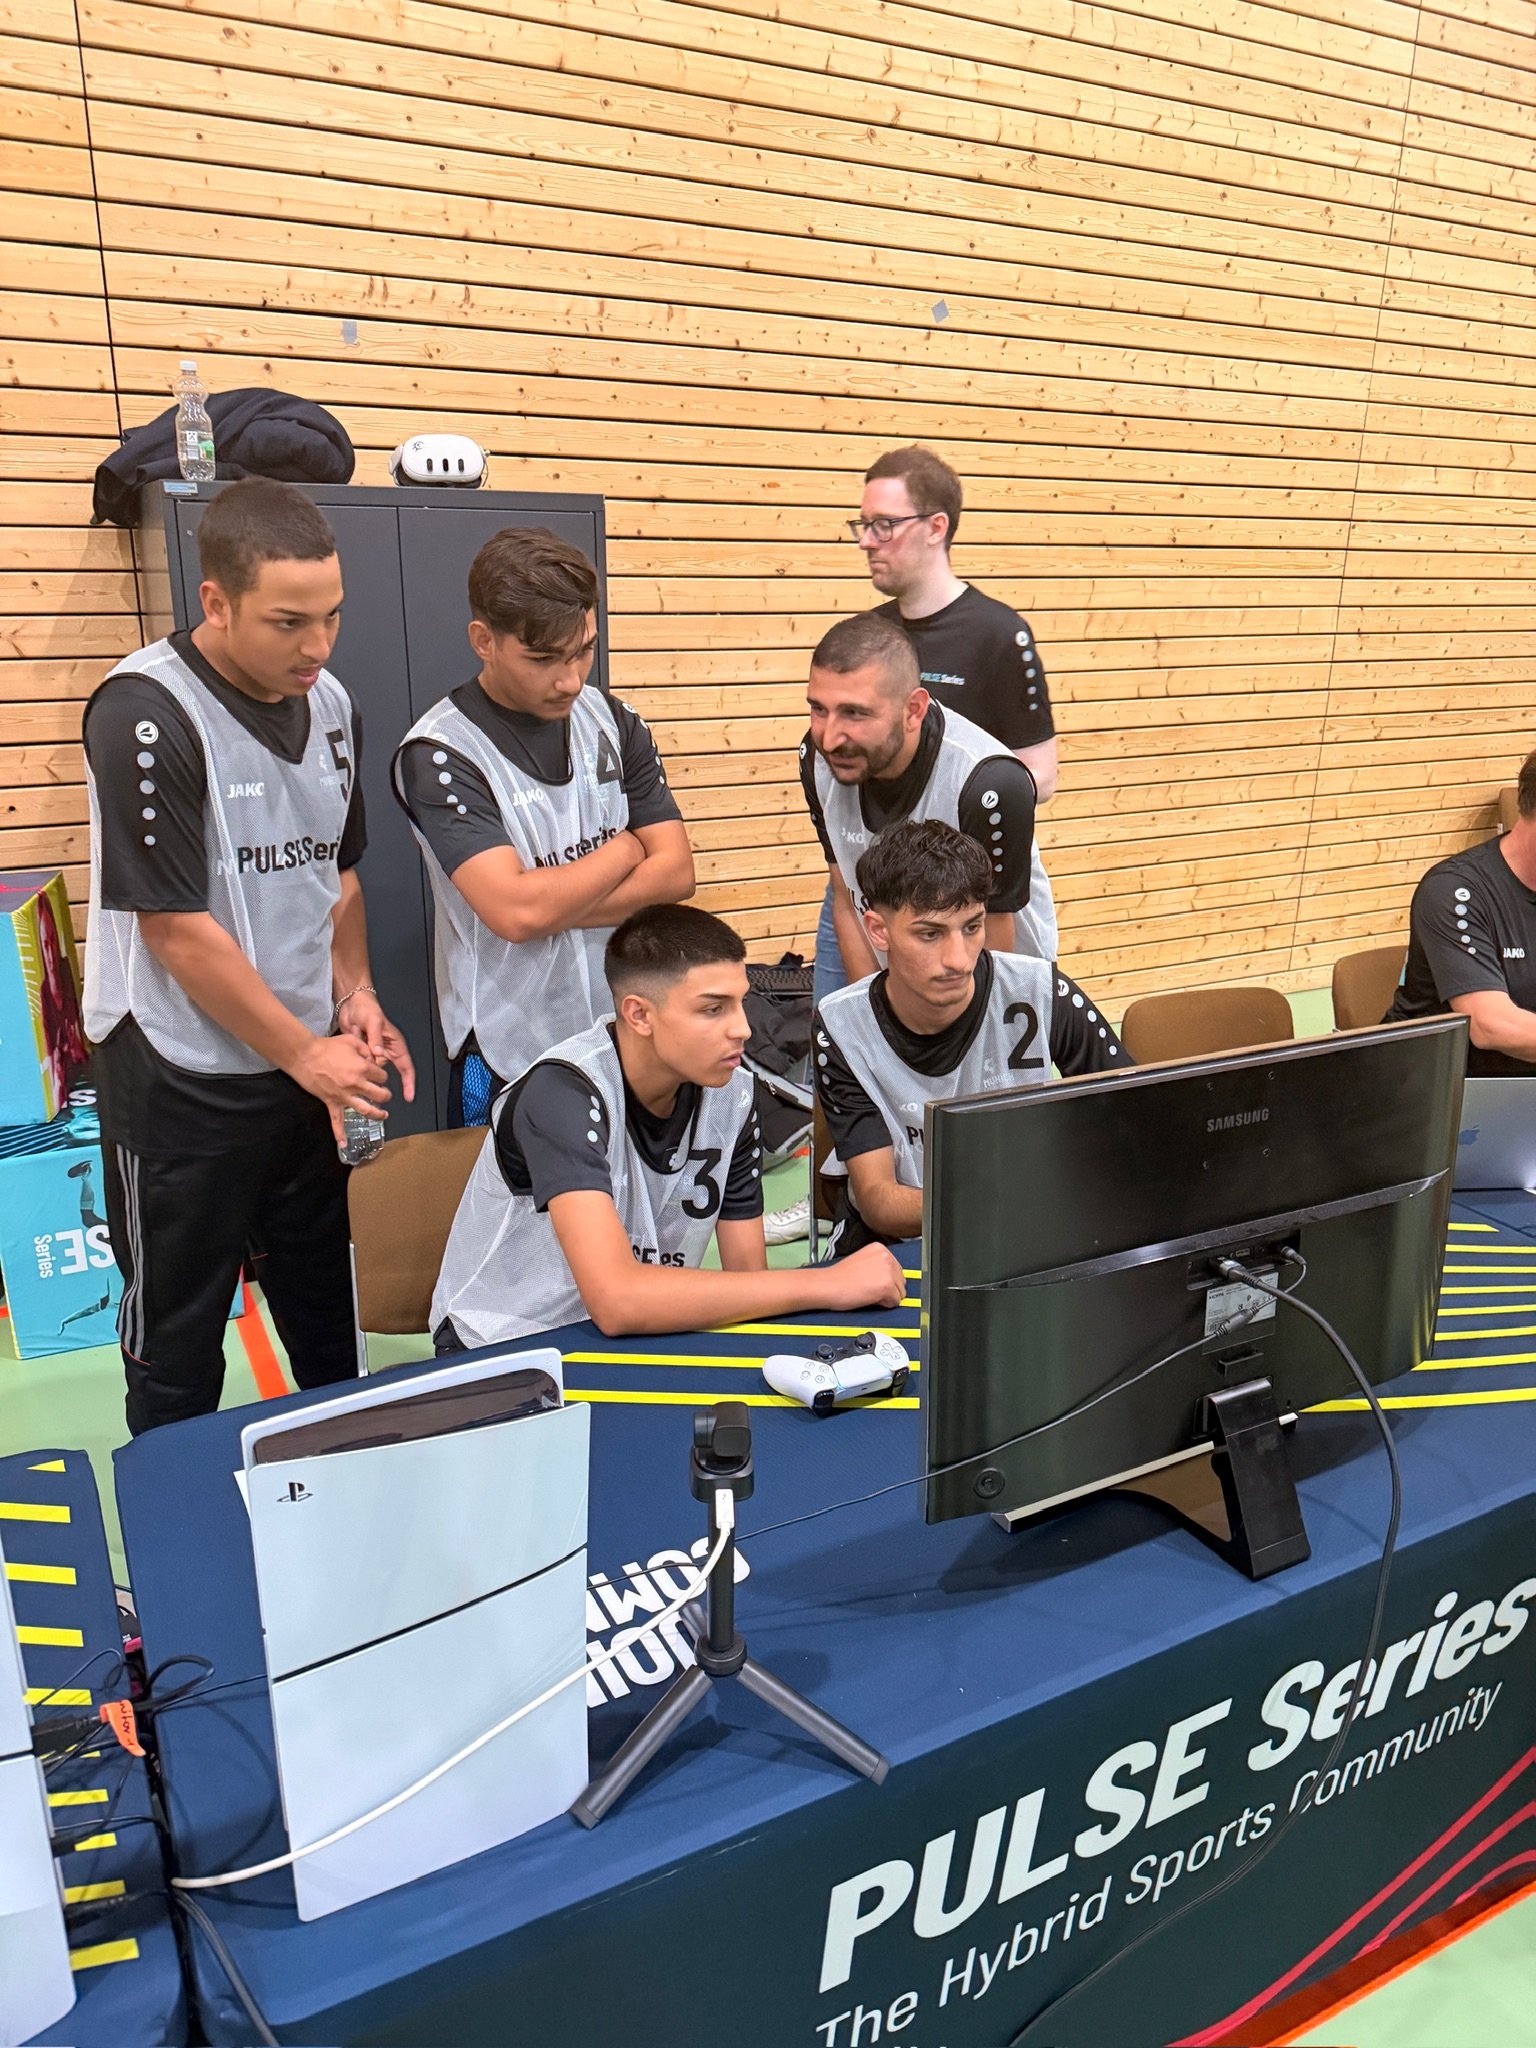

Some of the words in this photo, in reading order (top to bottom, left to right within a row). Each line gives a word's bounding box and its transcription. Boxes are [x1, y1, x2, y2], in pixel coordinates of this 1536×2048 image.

[596, 730, 627, 795] 4
[841, 827, 864, 843] JKO
[1503, 947, 1525, 959] JAKO
[1003, 1001, 1044, 1070] 2
[1207, 1107, 1269, 1133] SAMSUNG
[681, 1148, 722, 1220] 3
[33, 1232, 56, 1280] Series
[819, 1698, 1232, 1993] PULSE
[1248, 1578, 1536, 1770] Series
[815, 1992, 919, 2048] The
[938, 1876, 1113, 2008] Hybrid
[1125, 1802, 1276, 1904] Sports
[1288, 1681, 1503, 1815] Community
